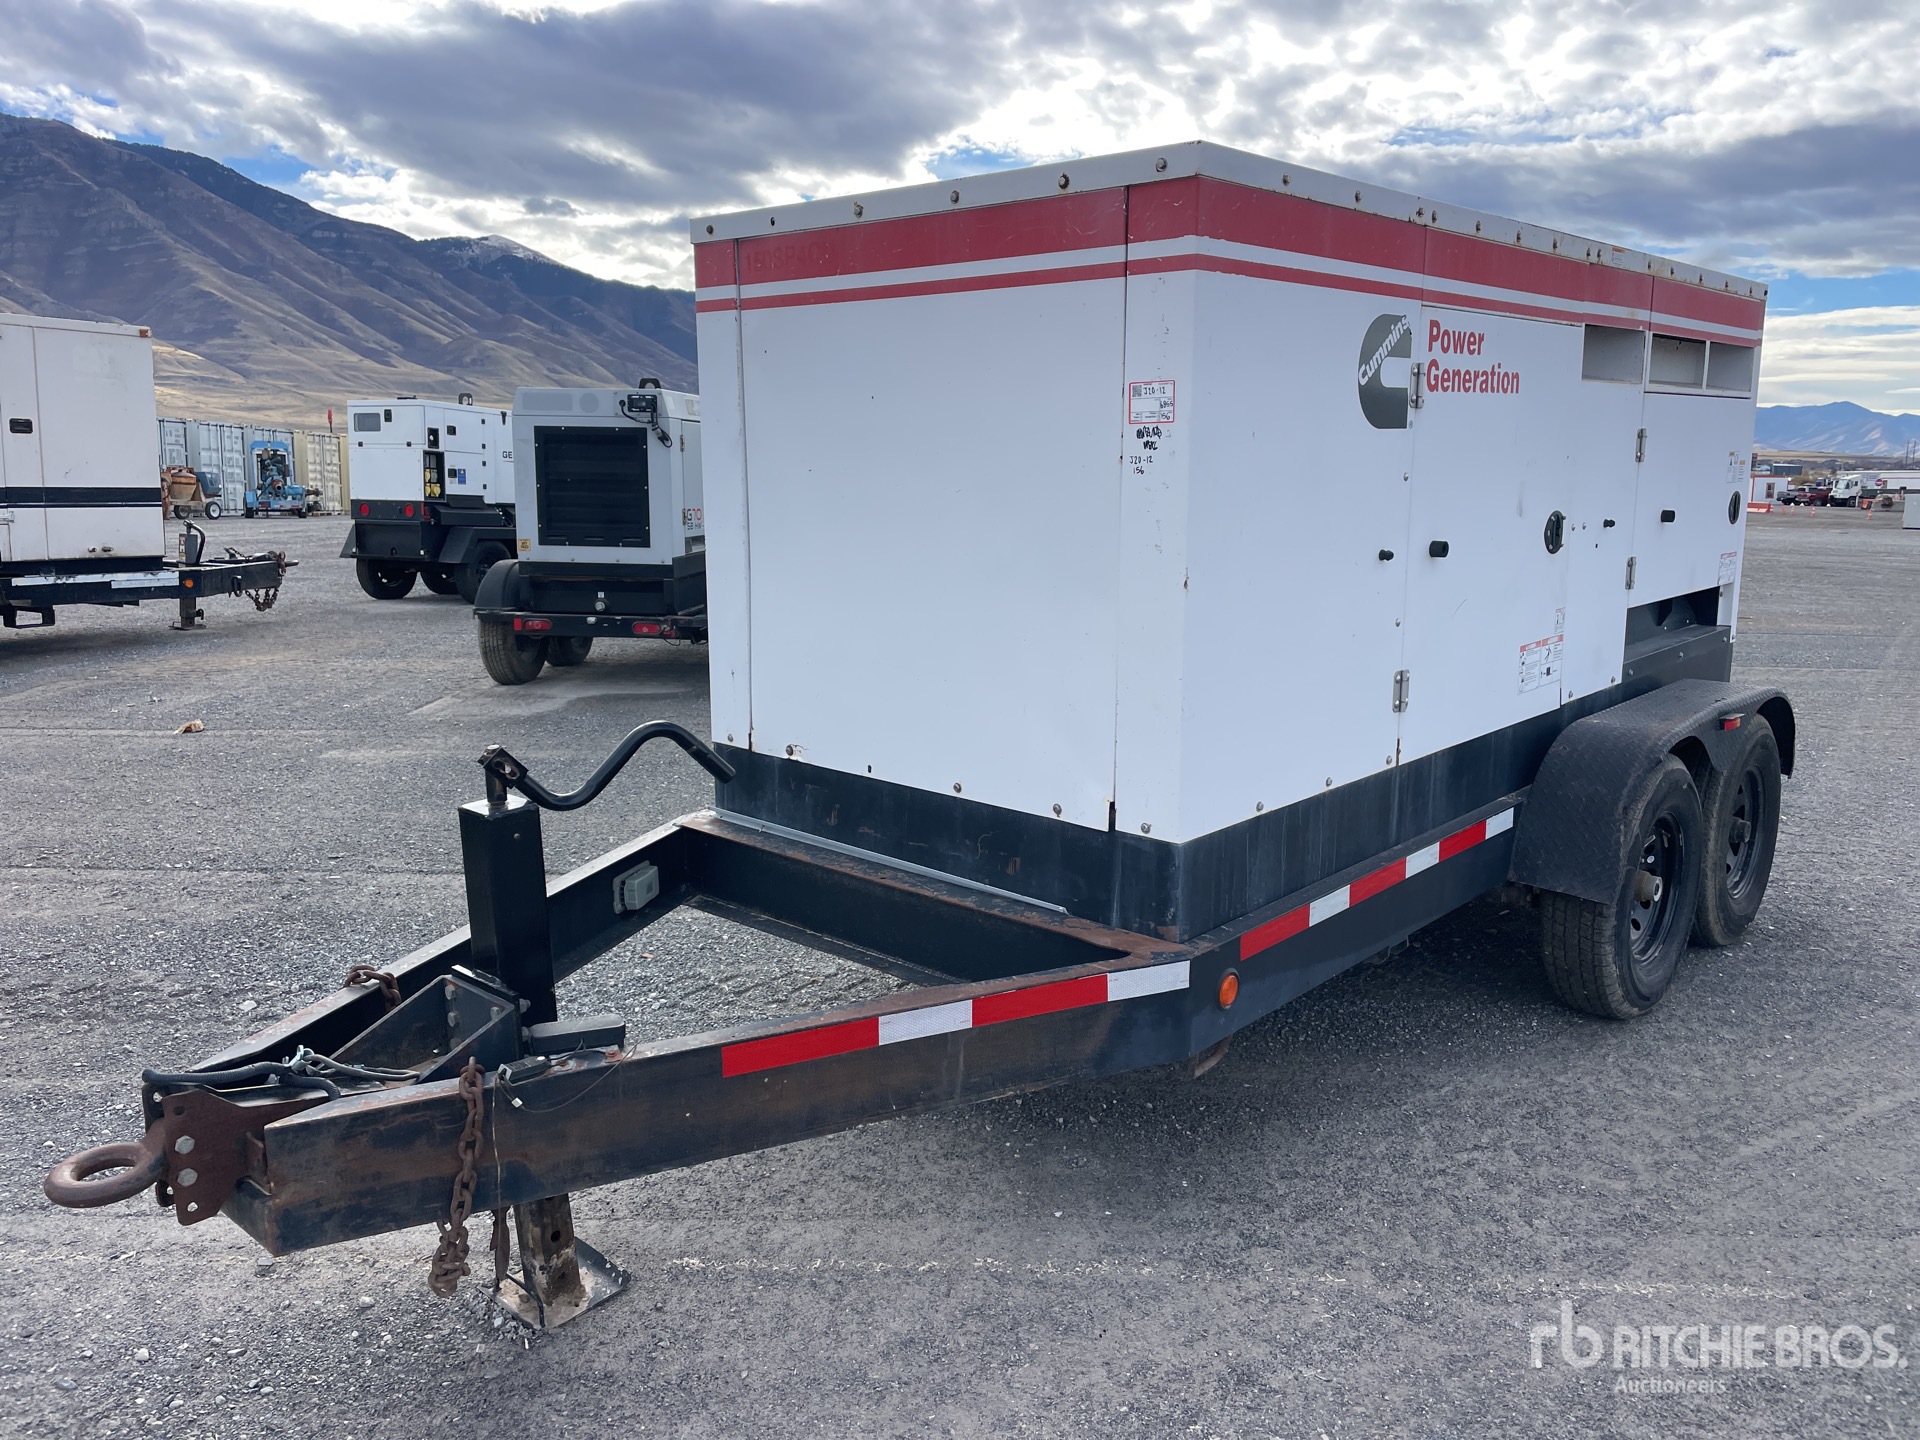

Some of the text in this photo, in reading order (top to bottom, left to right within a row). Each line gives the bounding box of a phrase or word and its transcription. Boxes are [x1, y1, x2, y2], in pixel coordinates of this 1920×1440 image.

[1358, 315, 1410, 386] Cummins
[1427, 319, 1485, 356] Power
[1426, 358, 1520, 394] Generation
[1130, 456, 1153, 464] J20-12
[1133, 466, 1144, 474] 156
